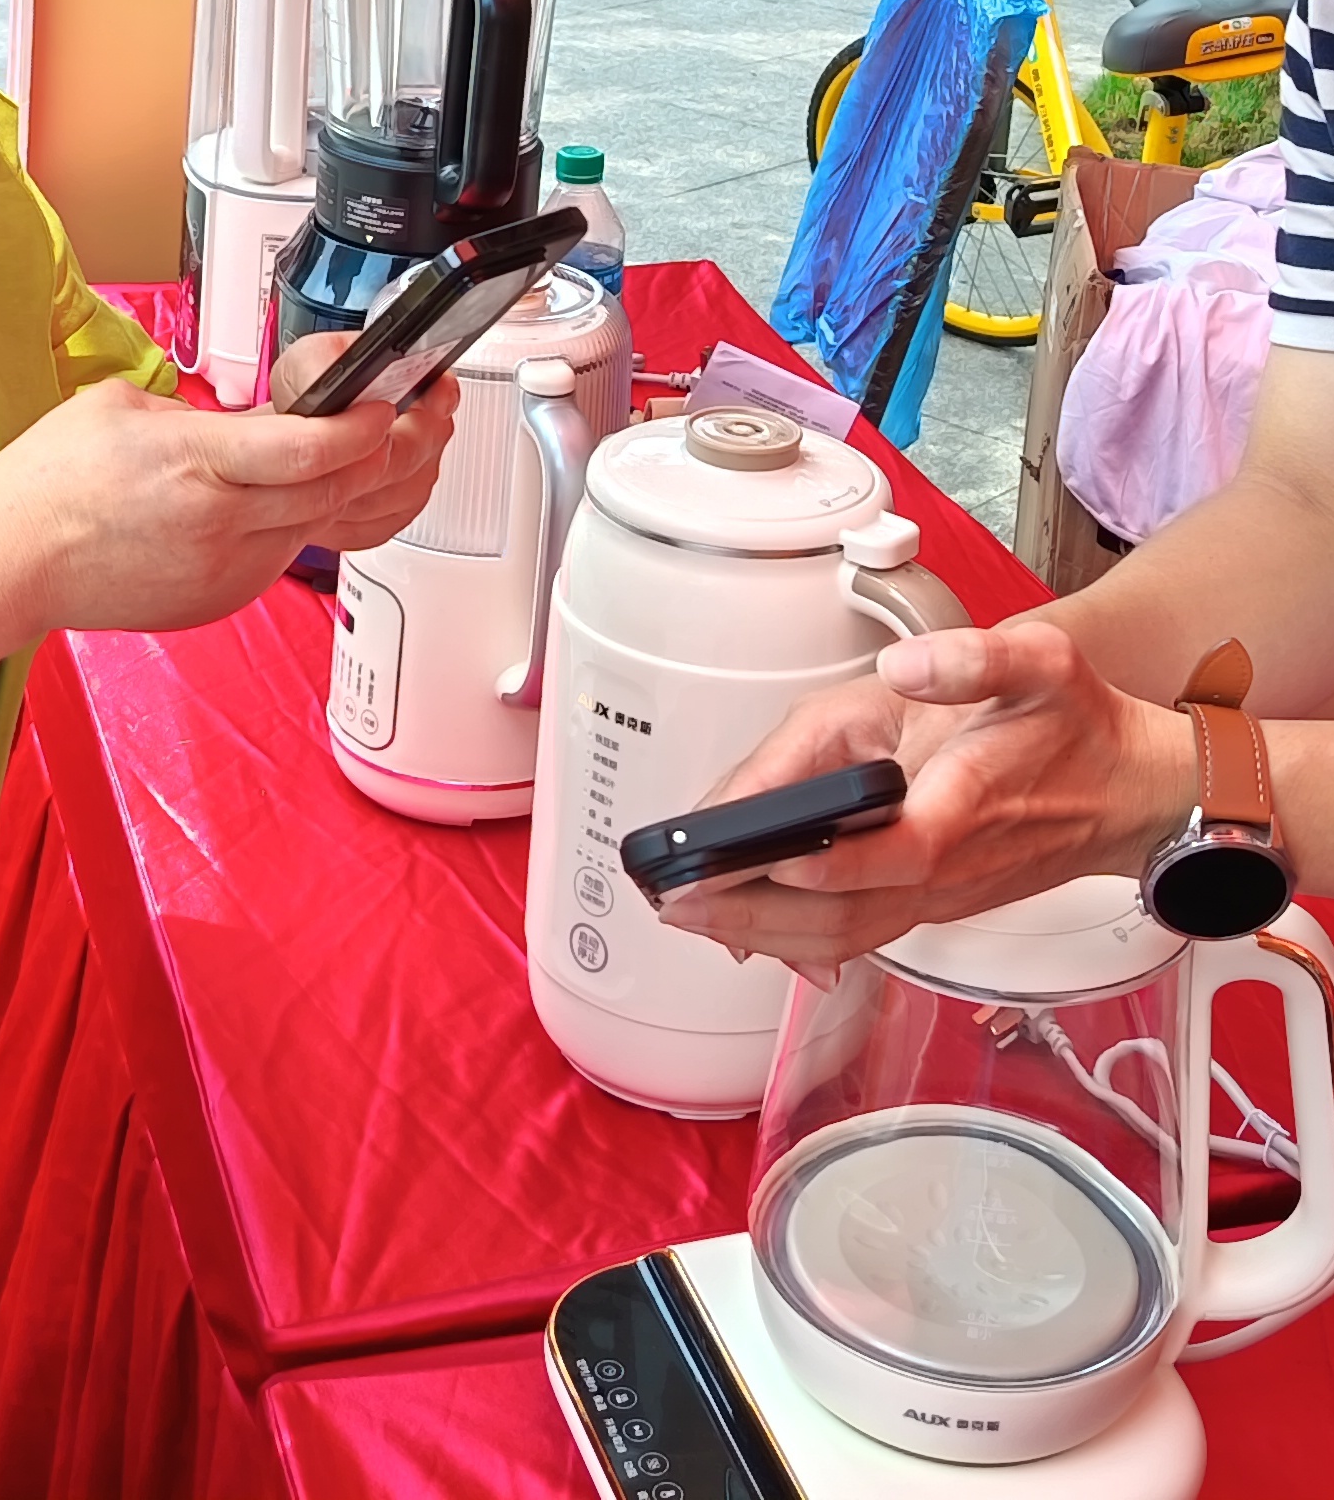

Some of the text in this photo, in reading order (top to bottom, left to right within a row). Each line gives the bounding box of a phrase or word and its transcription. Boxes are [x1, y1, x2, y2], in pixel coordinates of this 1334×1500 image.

[577, 692, 652, 736] AUX 奥克斯
[903, 1408, 1001, 1432] AUX 奥克斯
